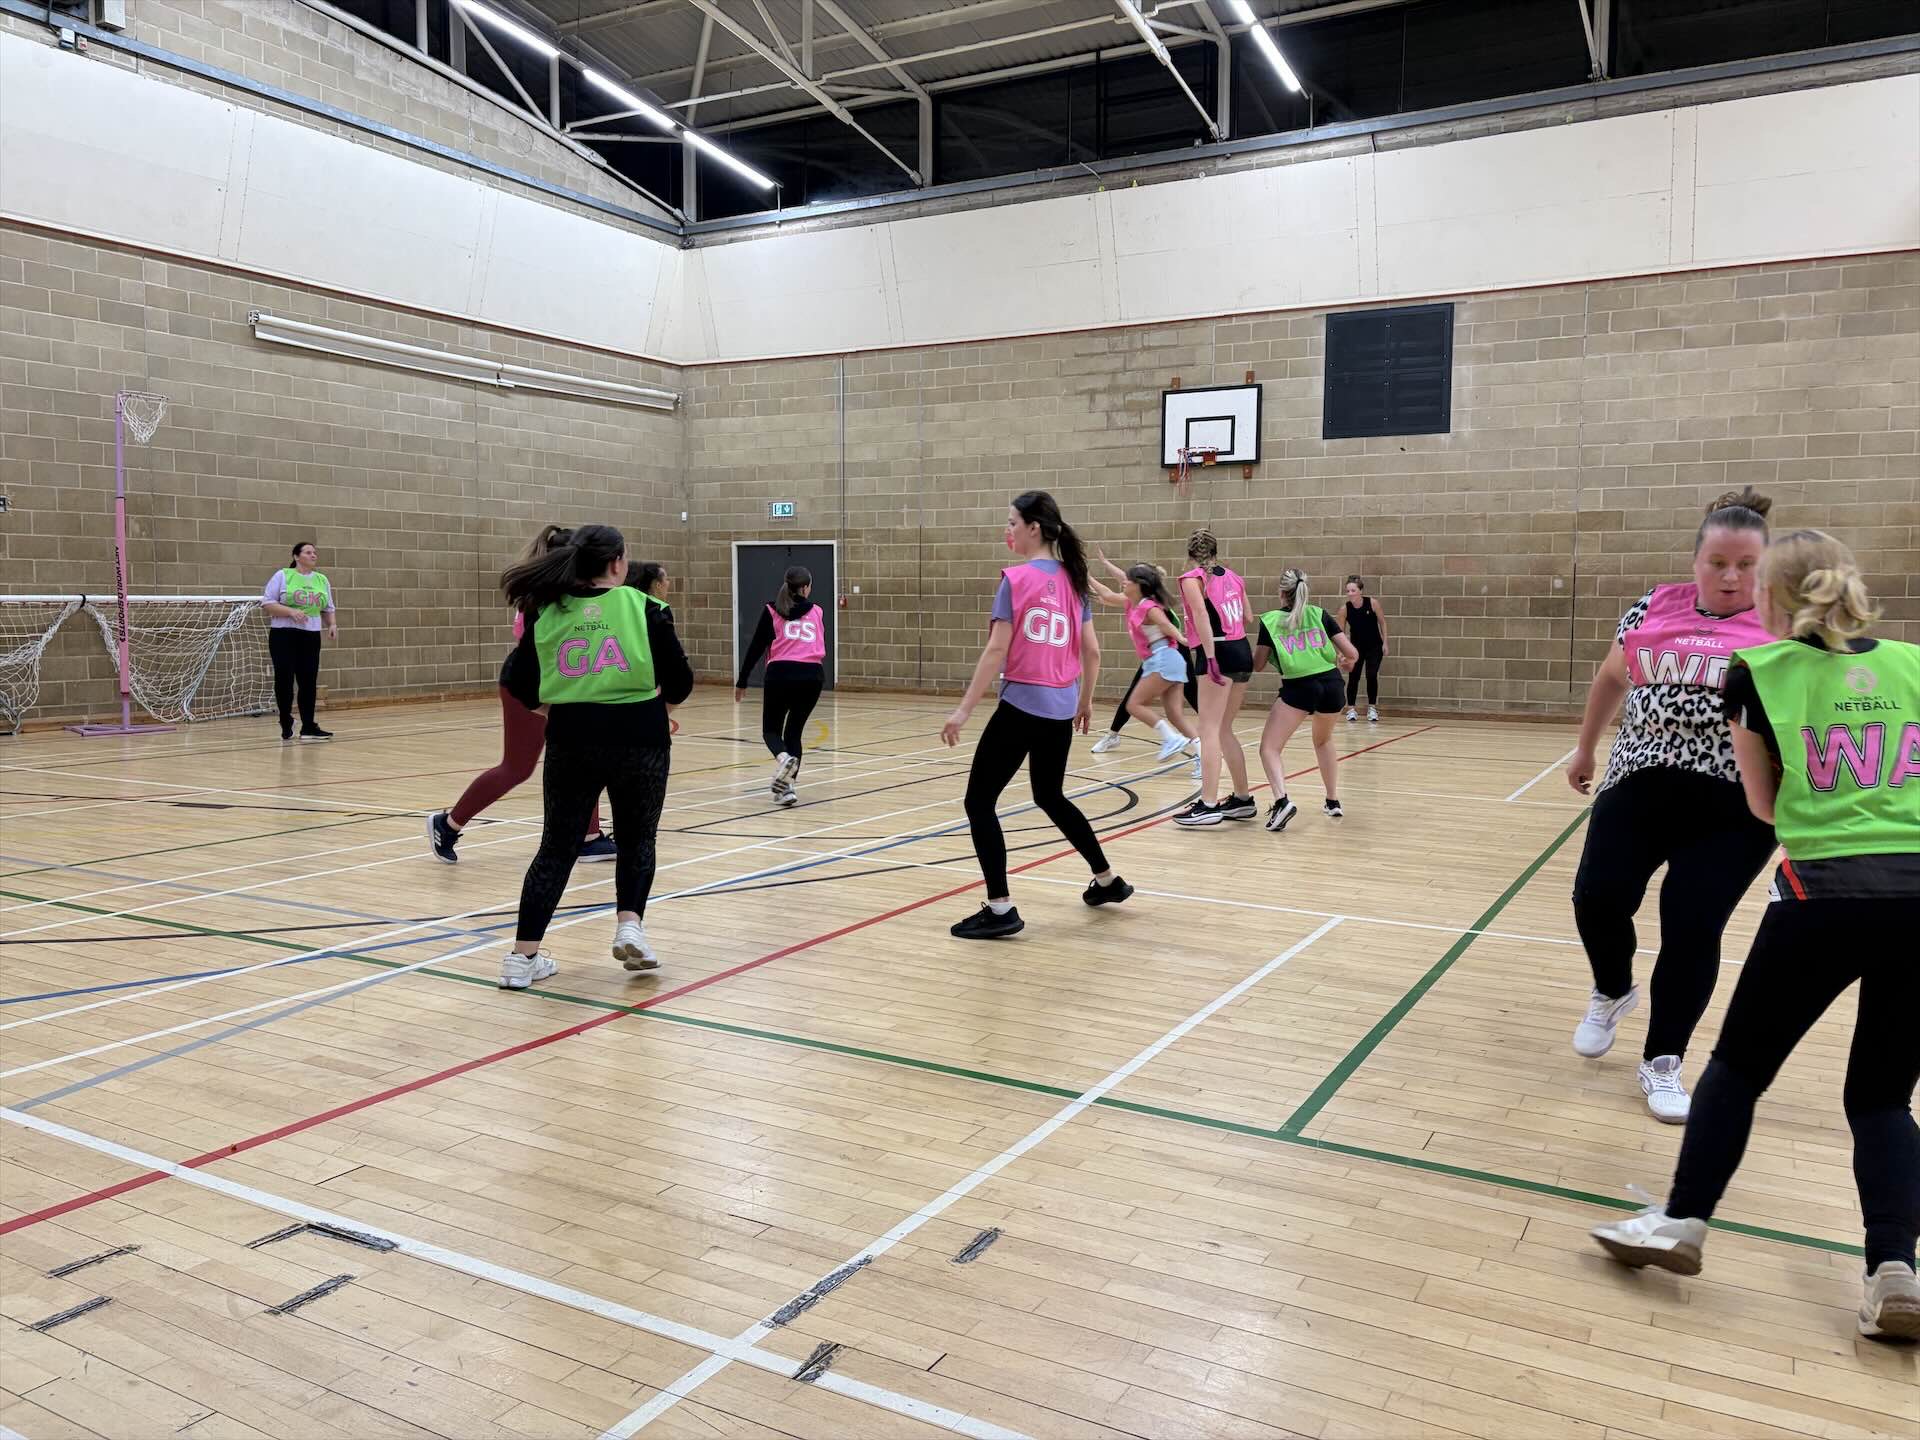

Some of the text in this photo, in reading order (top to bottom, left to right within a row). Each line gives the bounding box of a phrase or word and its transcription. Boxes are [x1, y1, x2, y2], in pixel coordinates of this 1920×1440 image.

[293, 589, 321, 608] GK
[574, 623, 609, 632] NETBALL
[783, 620, 817, 643] GS
[1023, 606, 1071, 648] GD
[1279, 628, 1327, 656] WD
[1674, 637, 1725, 649] NETBALL
[557, 634, 631, 679] GA
[1834, 700, 1902, 713] NETBALL
[1800, 721, 1920, 792] WA
